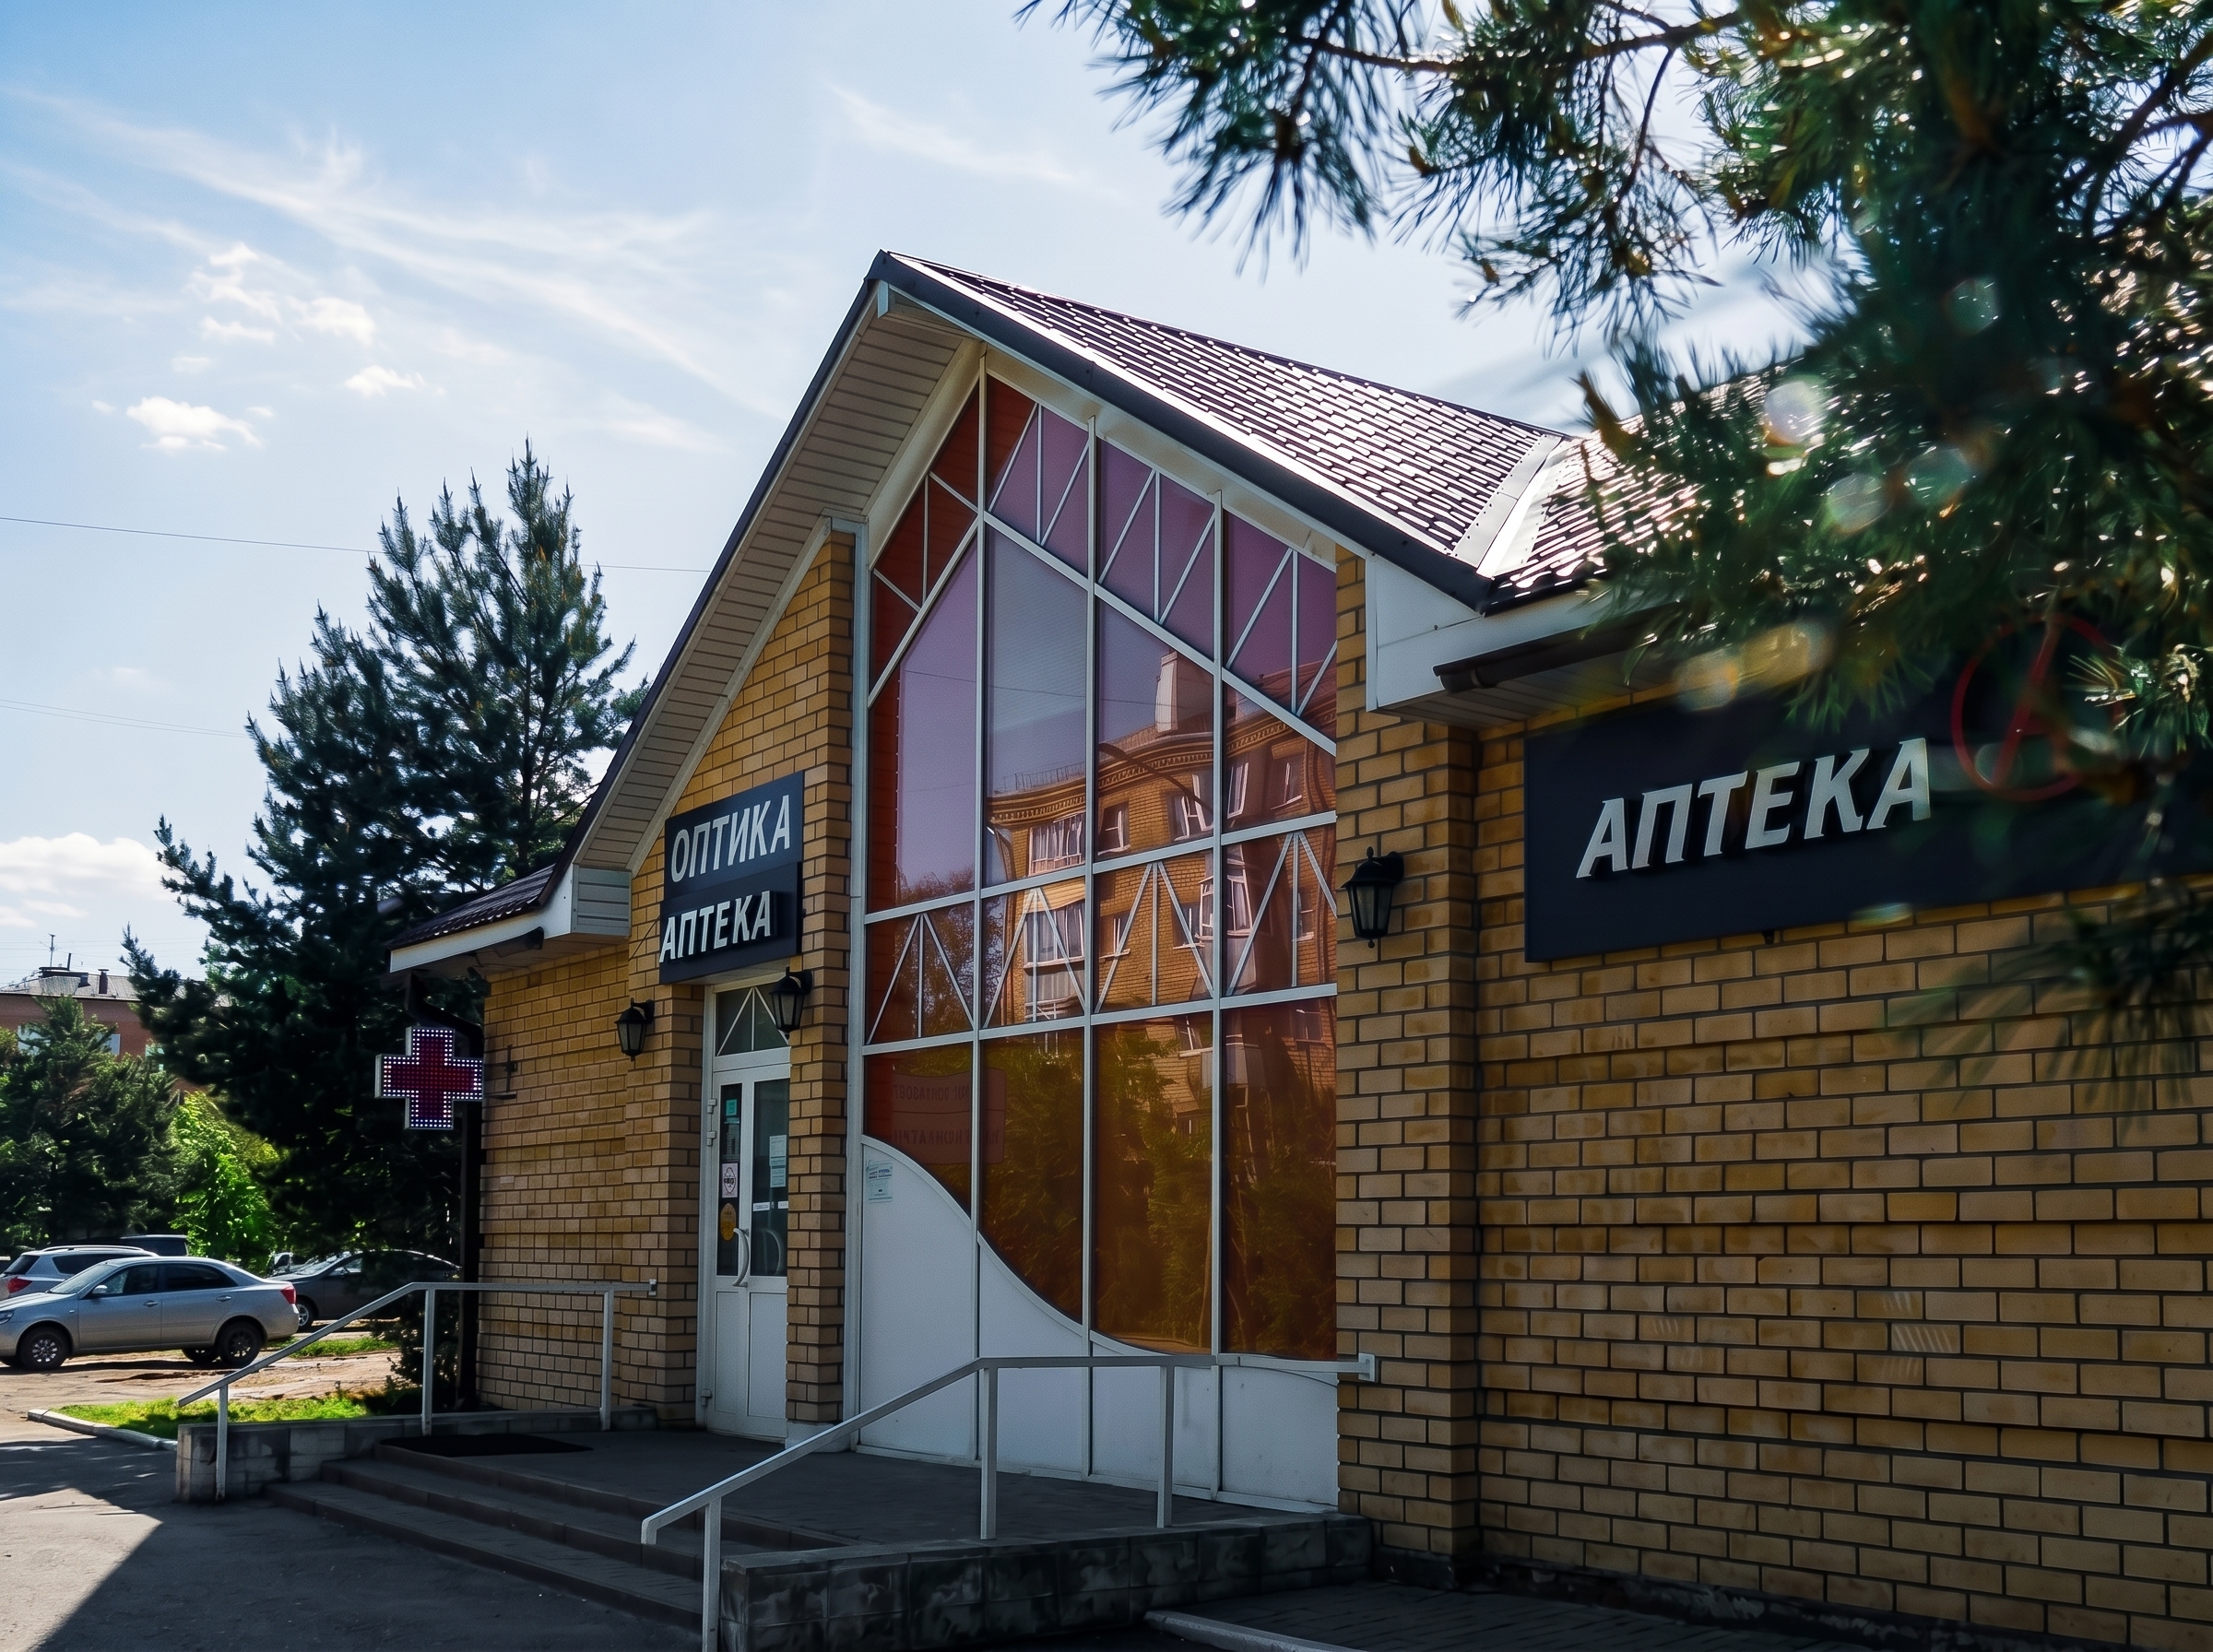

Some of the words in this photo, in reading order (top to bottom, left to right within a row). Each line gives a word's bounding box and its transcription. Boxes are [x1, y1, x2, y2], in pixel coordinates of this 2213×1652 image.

[670, 794, 791, 883] ОПТИКА
[1575, 737, 1932, 879] АПТЕКА
[658, 890, 773, 963] АПТЕКА
